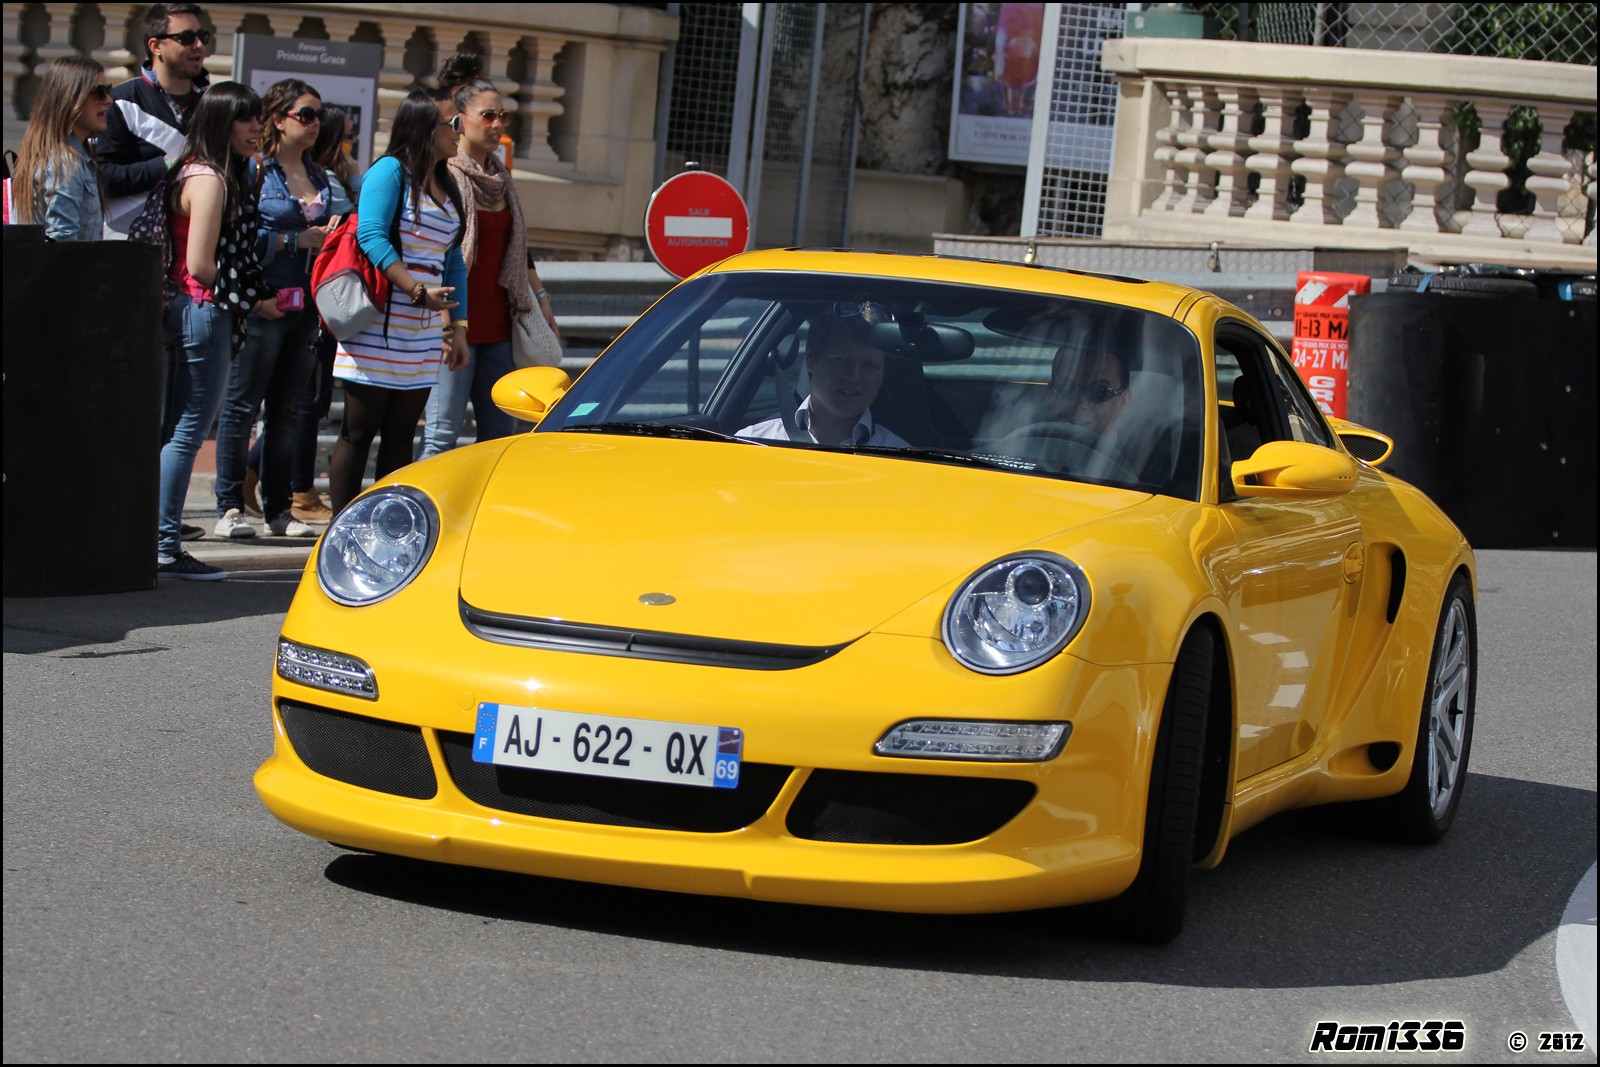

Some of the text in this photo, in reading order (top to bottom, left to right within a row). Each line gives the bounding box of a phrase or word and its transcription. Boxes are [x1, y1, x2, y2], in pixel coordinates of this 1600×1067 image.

[276, 49, 346, 65] Princesse Grace
[688, 208, 710, 216] SAUF
[667, 238, 729, 247] AUTORISATION
[1293, 348, 1327, 369] 24-27
[478, 737, 488, 749] F
[715, 759, 739, 780] 69
